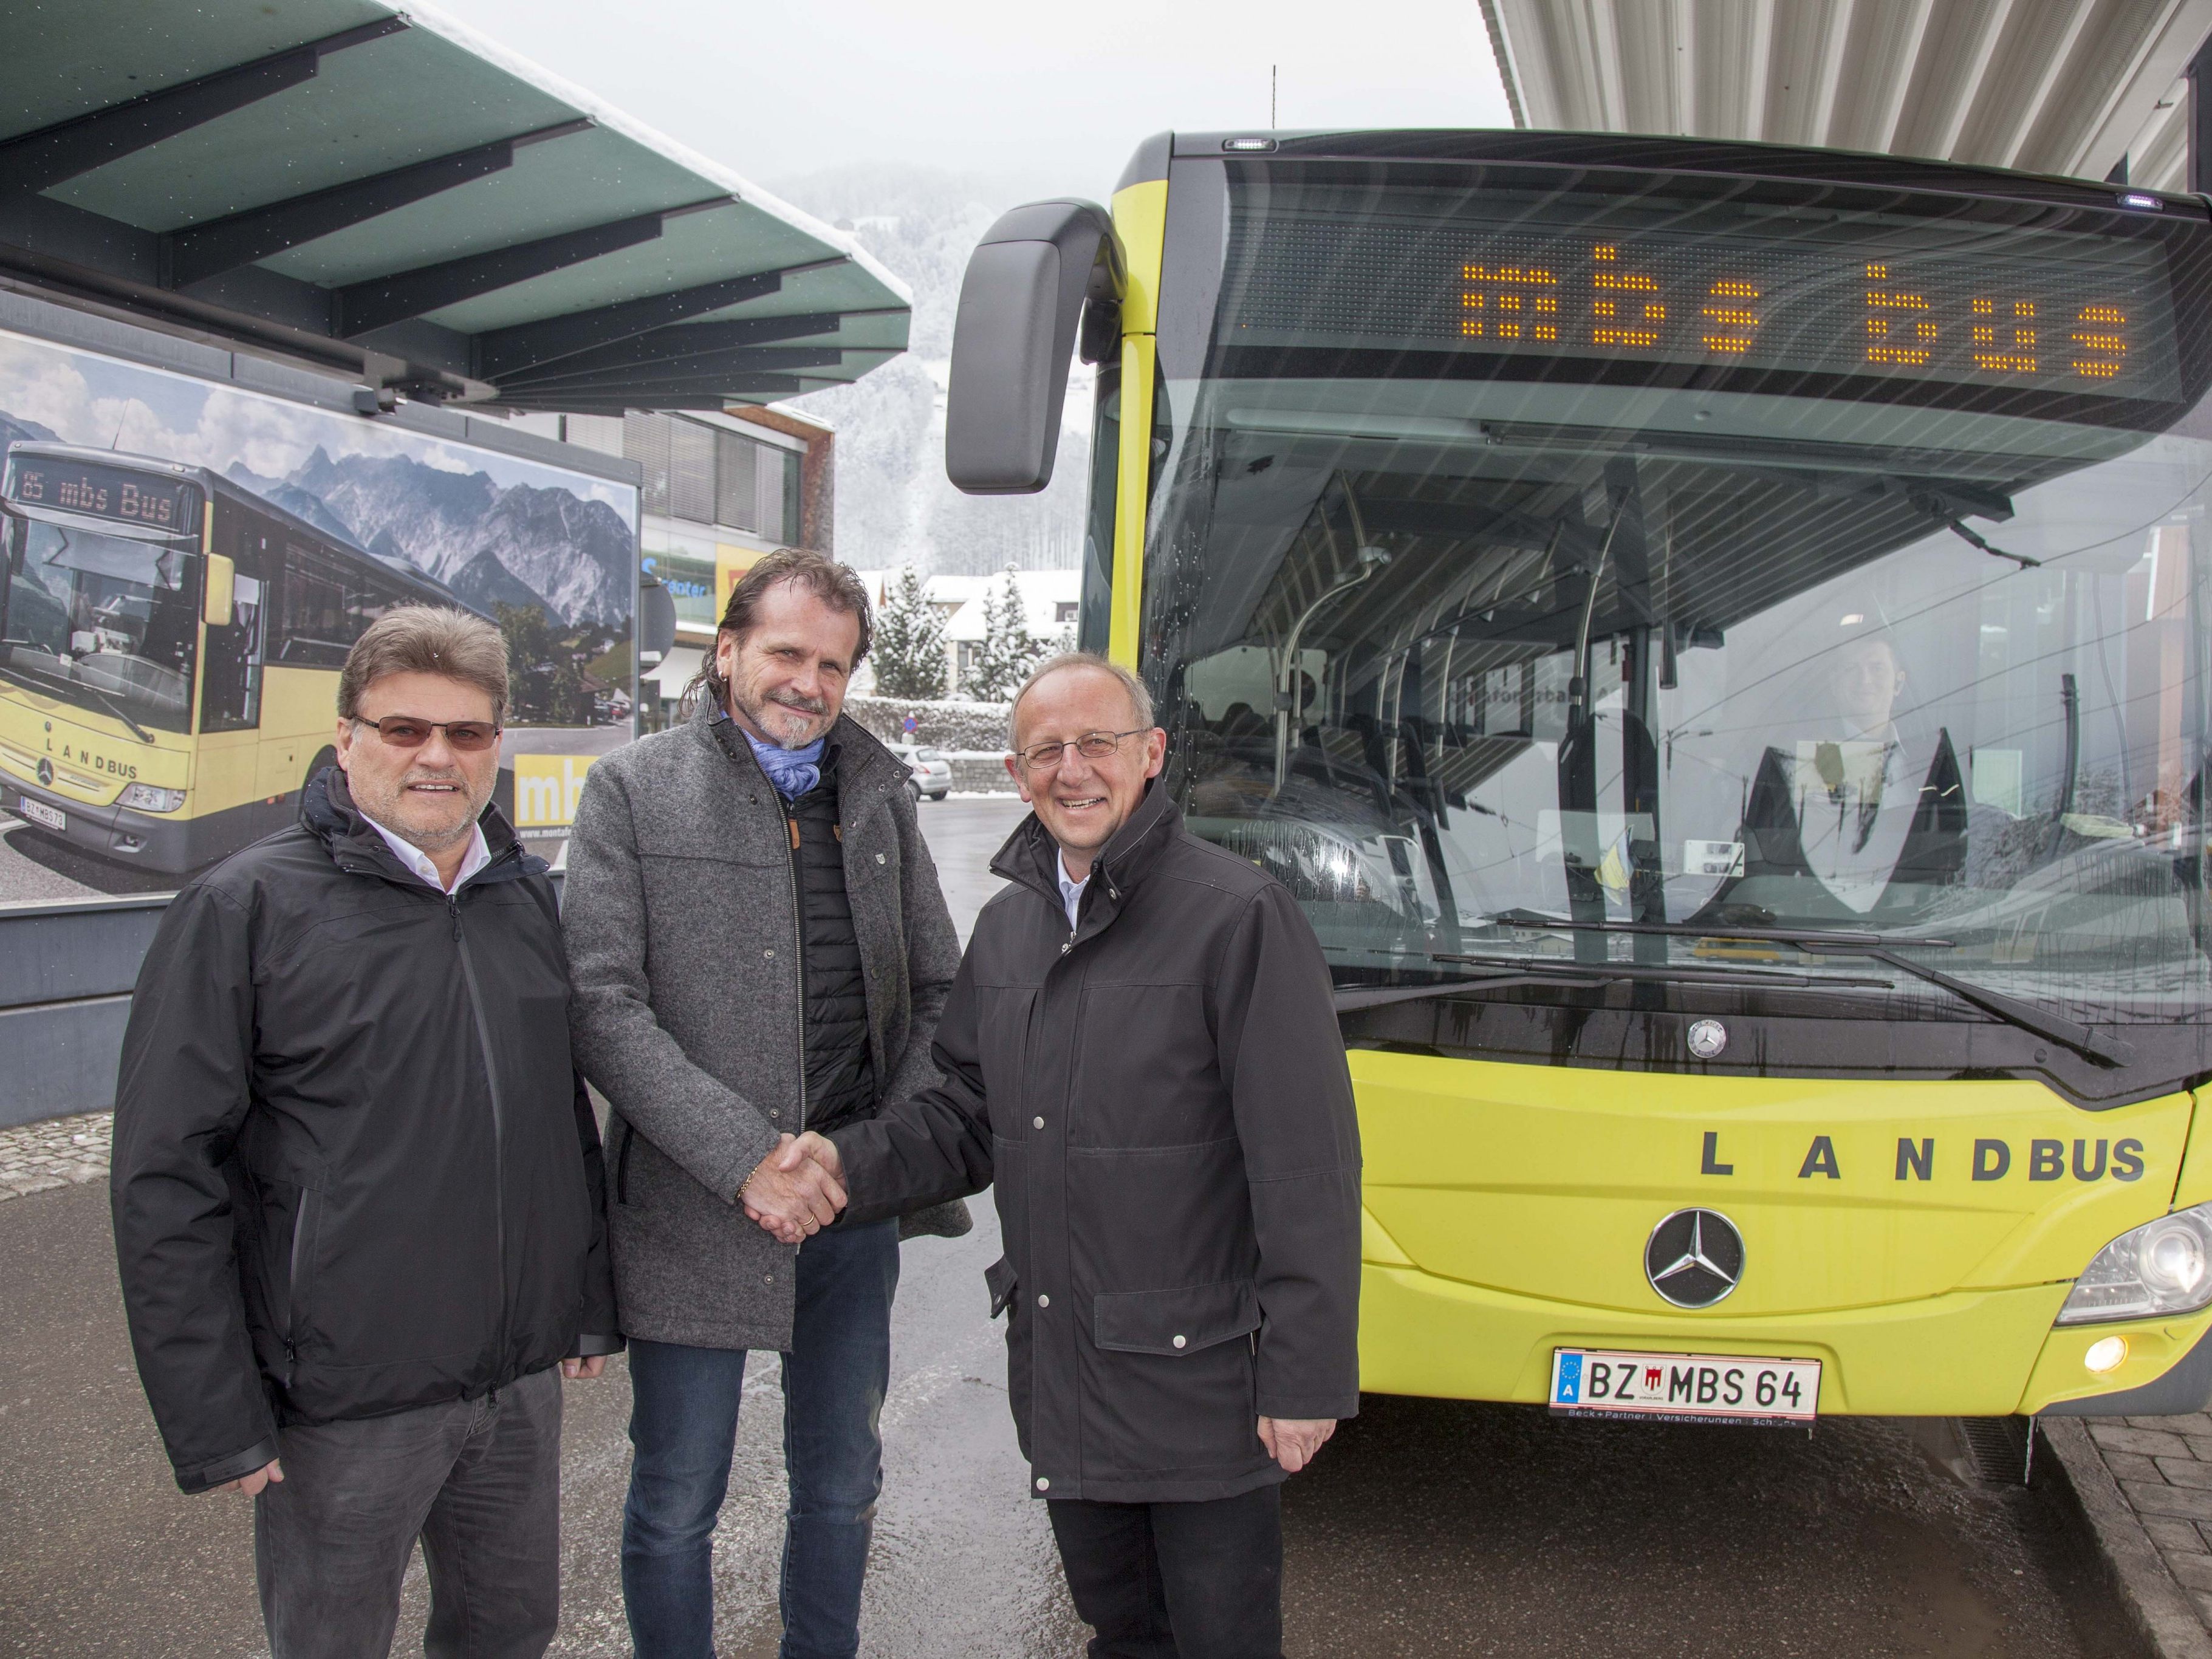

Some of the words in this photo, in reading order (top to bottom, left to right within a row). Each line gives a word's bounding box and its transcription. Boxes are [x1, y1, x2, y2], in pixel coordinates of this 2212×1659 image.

[1462, 245, 1761, 354] mbs
[1866, 264, 2128, 378] bus
[60, 477, 108, 511] mbs
[120, 484, 171, 522] Bus
[46, 737, 137, 779] LANDBUS
[1700, 1131, 2144, 1182] LANDBUS
[1563, 1384, 1573, 1397] A
[1589, 1362, 1638, 1400] BZ
[1668, 1365, 1744, 1405] MBS
[1755, 1370, 1801, 1408] 64
[1656, 1413, 1742, 1425] Versicherungen
